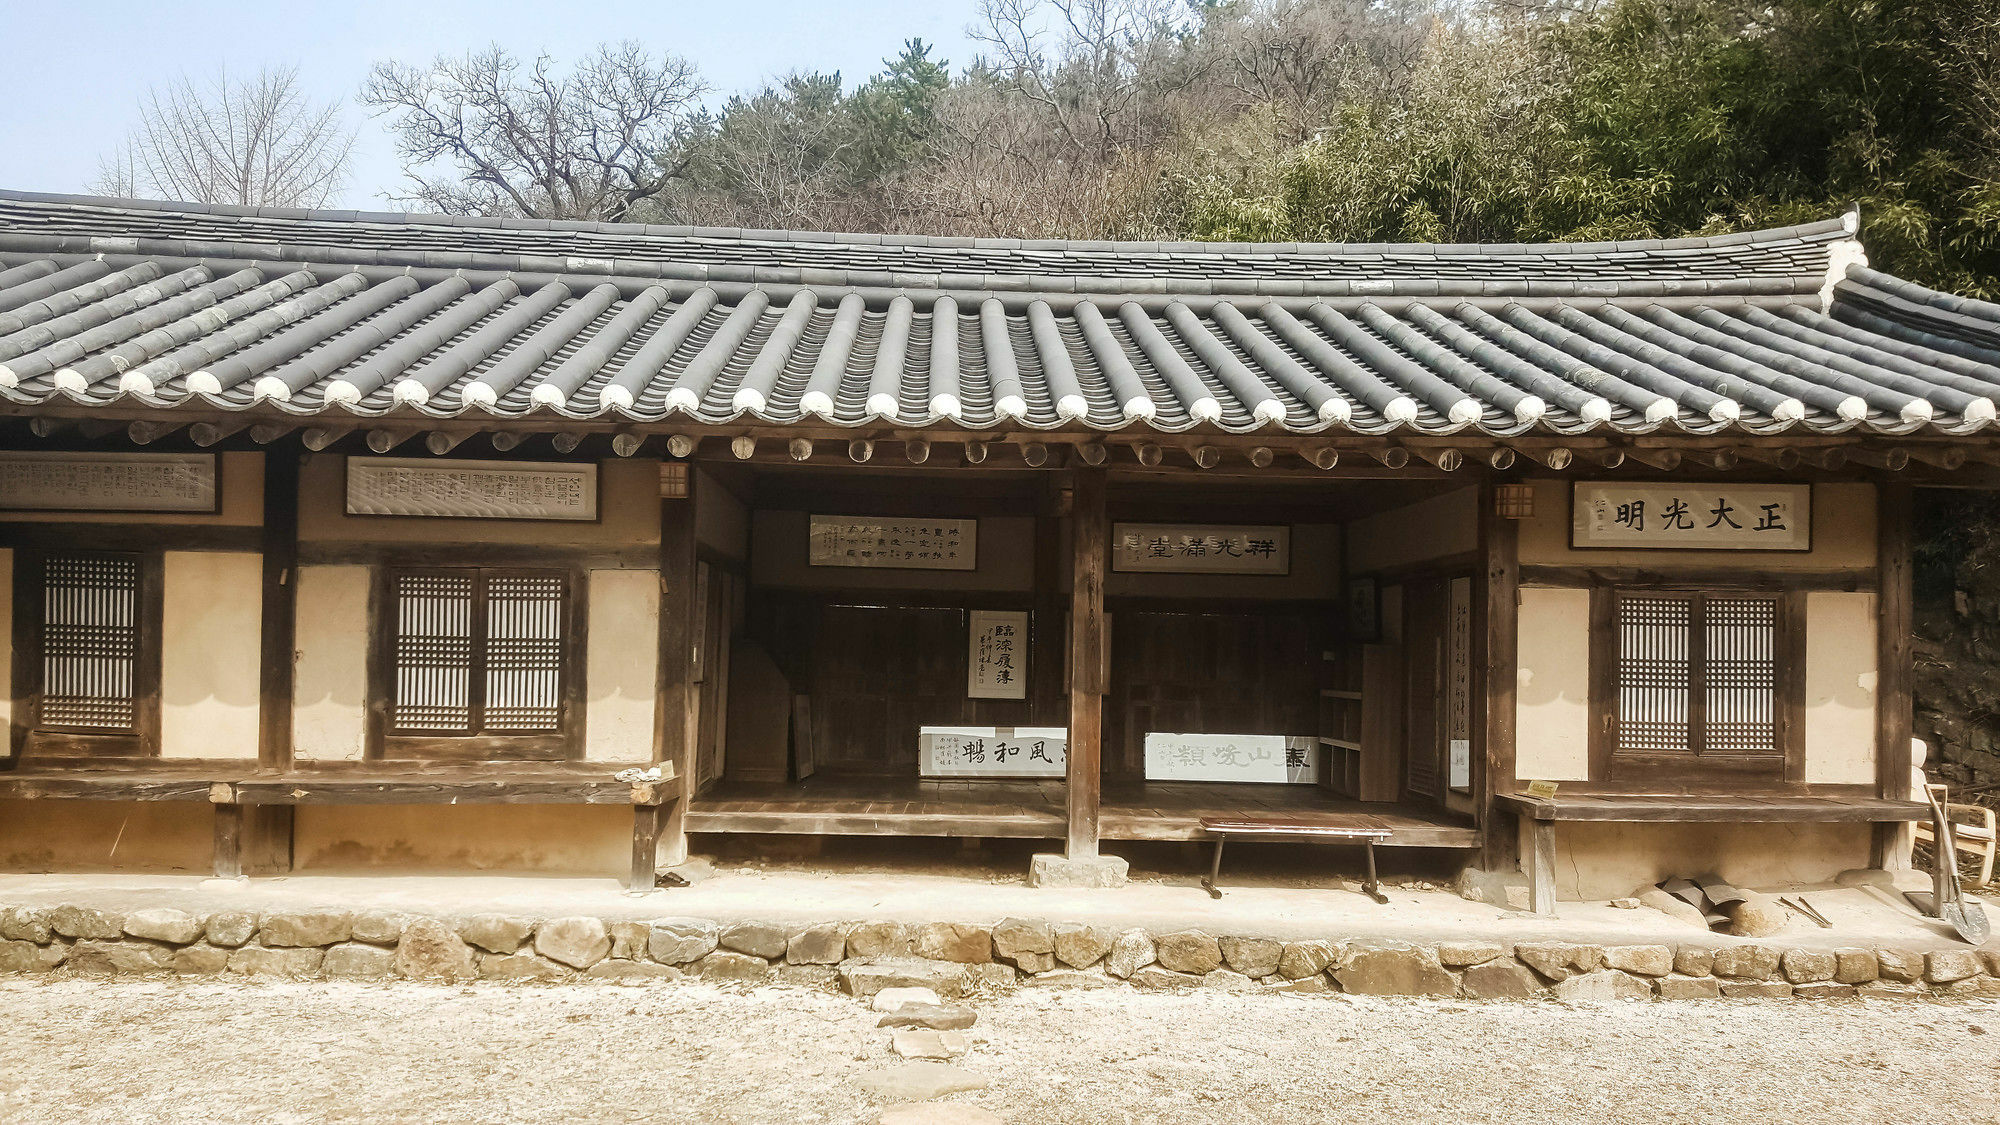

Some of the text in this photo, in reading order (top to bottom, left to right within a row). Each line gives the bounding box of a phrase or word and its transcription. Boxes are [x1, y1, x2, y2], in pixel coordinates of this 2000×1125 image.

[1614, 498, 1786, 531] 正大光明
[994, 625, 1015, 685] 臨深履薄
